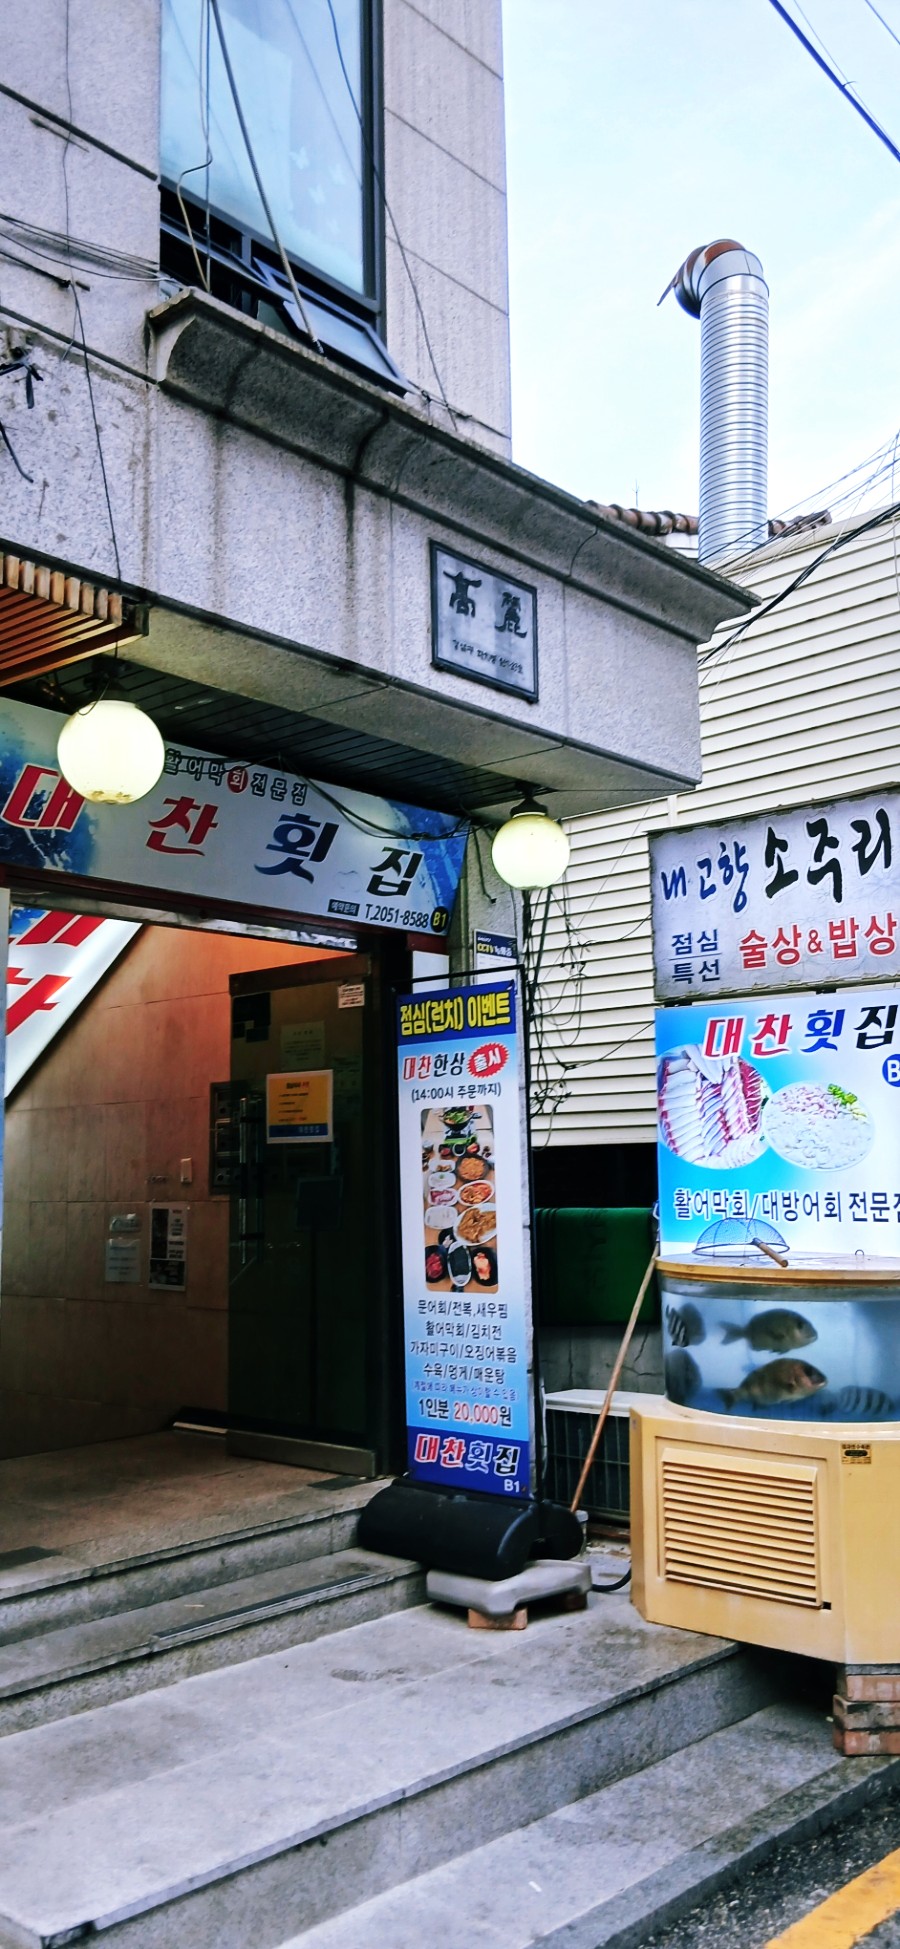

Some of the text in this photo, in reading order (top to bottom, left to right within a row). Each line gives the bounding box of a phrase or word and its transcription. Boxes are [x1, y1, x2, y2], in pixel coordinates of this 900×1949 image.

[764, 807, 892, 903] 소주리
[672, 929, 719, 956] 점심
[672, 959, 721, 984] 특선
[400, 991, 511, 1036] 점심(런치) 이벤트
[703, 1004, 899, 1058] 대찬횟집
[473, 1047, 502, 1073] 출시
[411, 1082, 502, 1103] (14:00시 주문까지)
[418, 1398, 513, 1427] 1인분 20,000원
[413, 1433, 520, 1477] 대찬횟집
[503, 1478, 520, 1493] B1
